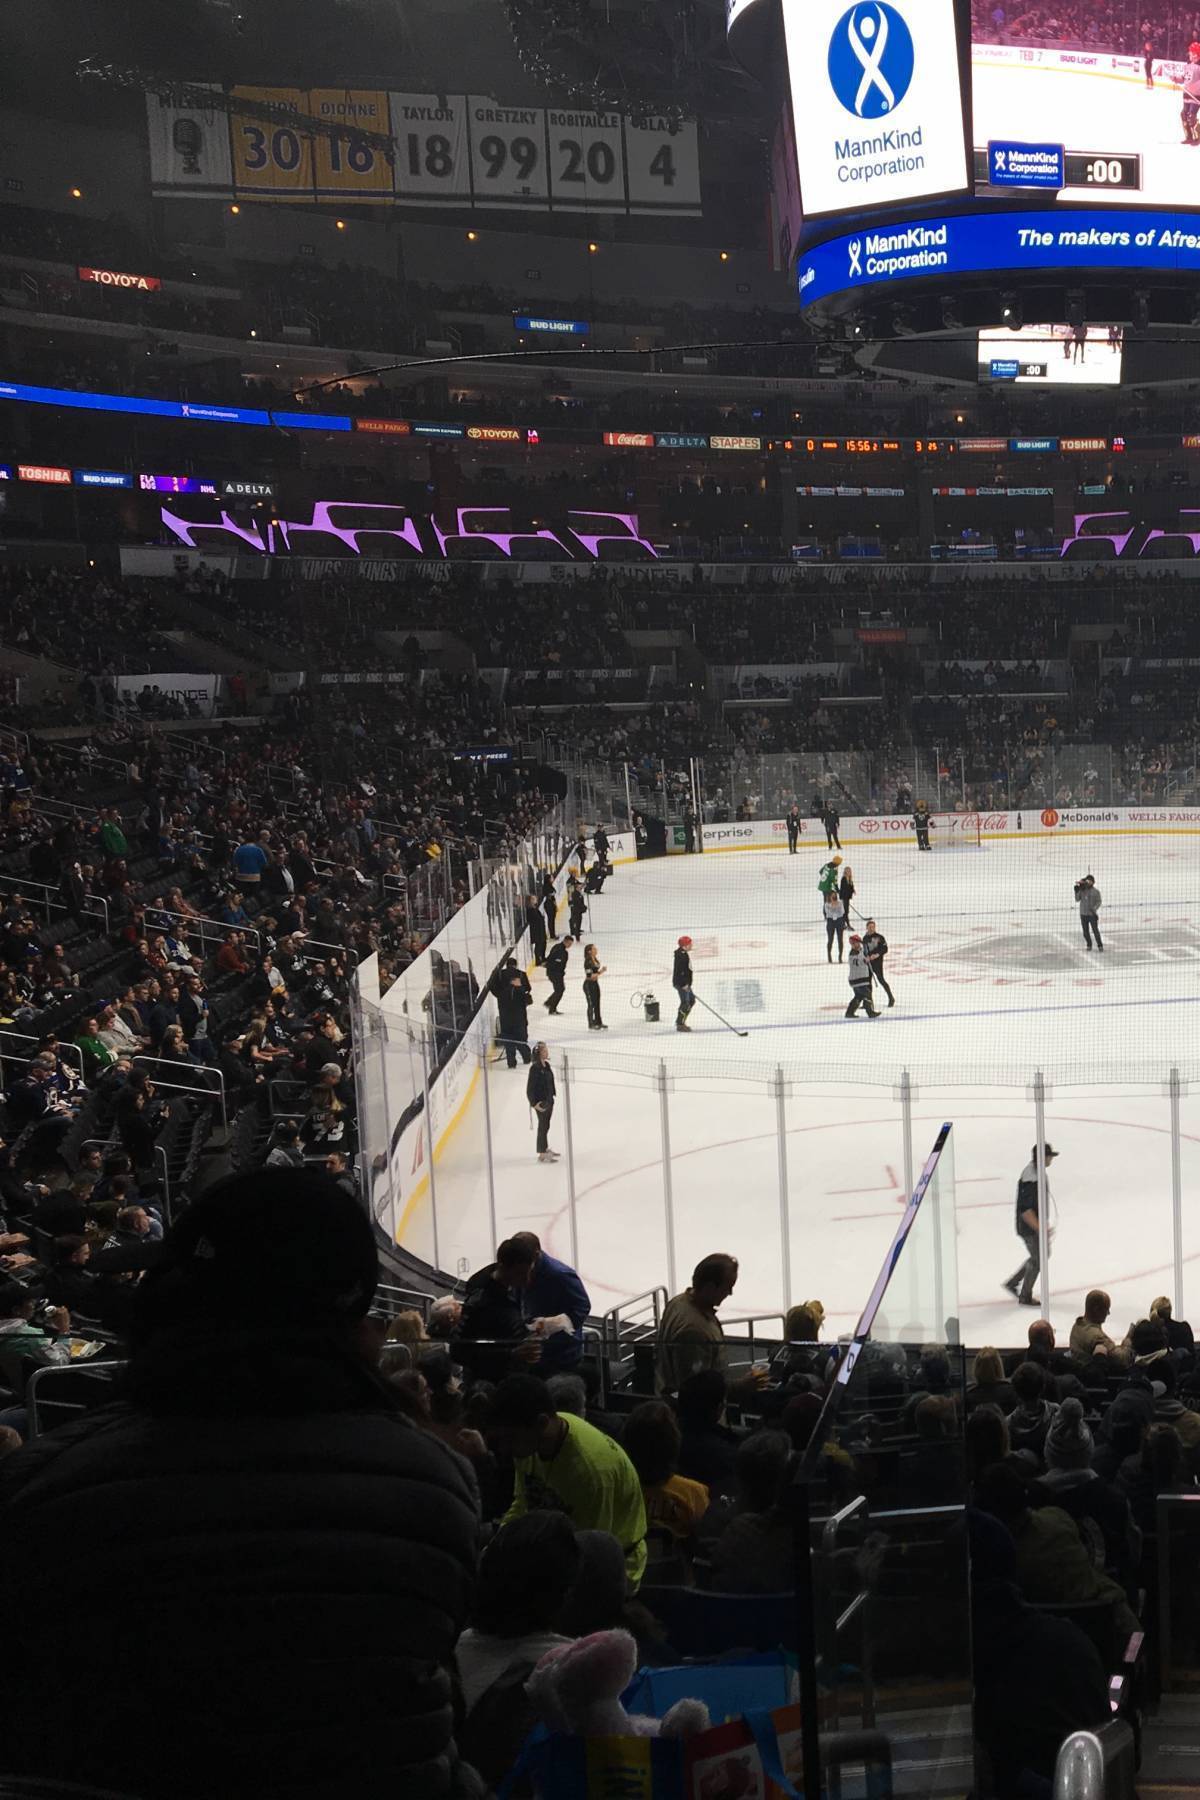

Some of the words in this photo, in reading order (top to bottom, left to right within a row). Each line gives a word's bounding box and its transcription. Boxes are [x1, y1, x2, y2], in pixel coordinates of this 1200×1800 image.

[321, 102, 376, 117] DIONNE
[402, 105, 454, 122] TAYLOR
[475, 108, 537, 125] GRETZKY
[550, 112, 620, 128] ROBITAILLE
[243, 126, 301, 171] 30
[834, 125, 923, 160] MannKind
[328, 130, 374, 173] 16
[408, 133, 453, 178] 18
[479, 135, 538, 180] 99
[1008, 151, 1058, 163] MannKind
[559, 139, 616, 185] 20
[649, 144, 677, 186] 4
[837, 155, 925, 183] Corporation
[1008, 161, 1058, 174] Corporation
[1086, 160, 1122, 184] :00
[866, 225, 947, 255] MannKind
[1017, 229, 1054, 246] The
[1058, 229, 1130, 246] makers
[1135, 229, 1155, 247] of
[866, 250, 947, 275] Corporation
[91, 270, 149, 290] TOYOTA
[529, 320, 550, 331] BUD
[550, 321, 574, 332] LIGHT
[482, 428, 520, 439] TOYOTA
[527, 429, 538, 437] LA
[670, 437, 707, 447] DELTA
[711, 437, 760, 449] STAPLES
[846, 439, 870, 451] 15:56
[1016, 441, 1030, 449] BUD
[1030, 441, 1050, 449] LIGHT
[1060, 440, 1107, 450] TOSHIBA
[18, 467, 70, 482] TOSHIBA
[83, 475, 102, 483] BUD
[102, 476, 125, 485] LIGHT
[139, 474, 155, 482] FLA
[200, 485, 217, 494] NHL
[236, 484, 272, 495] DELTA
[1061, 812, 1119, 823] McDonald's
[1128, 812, 1165, 822] WELLS
